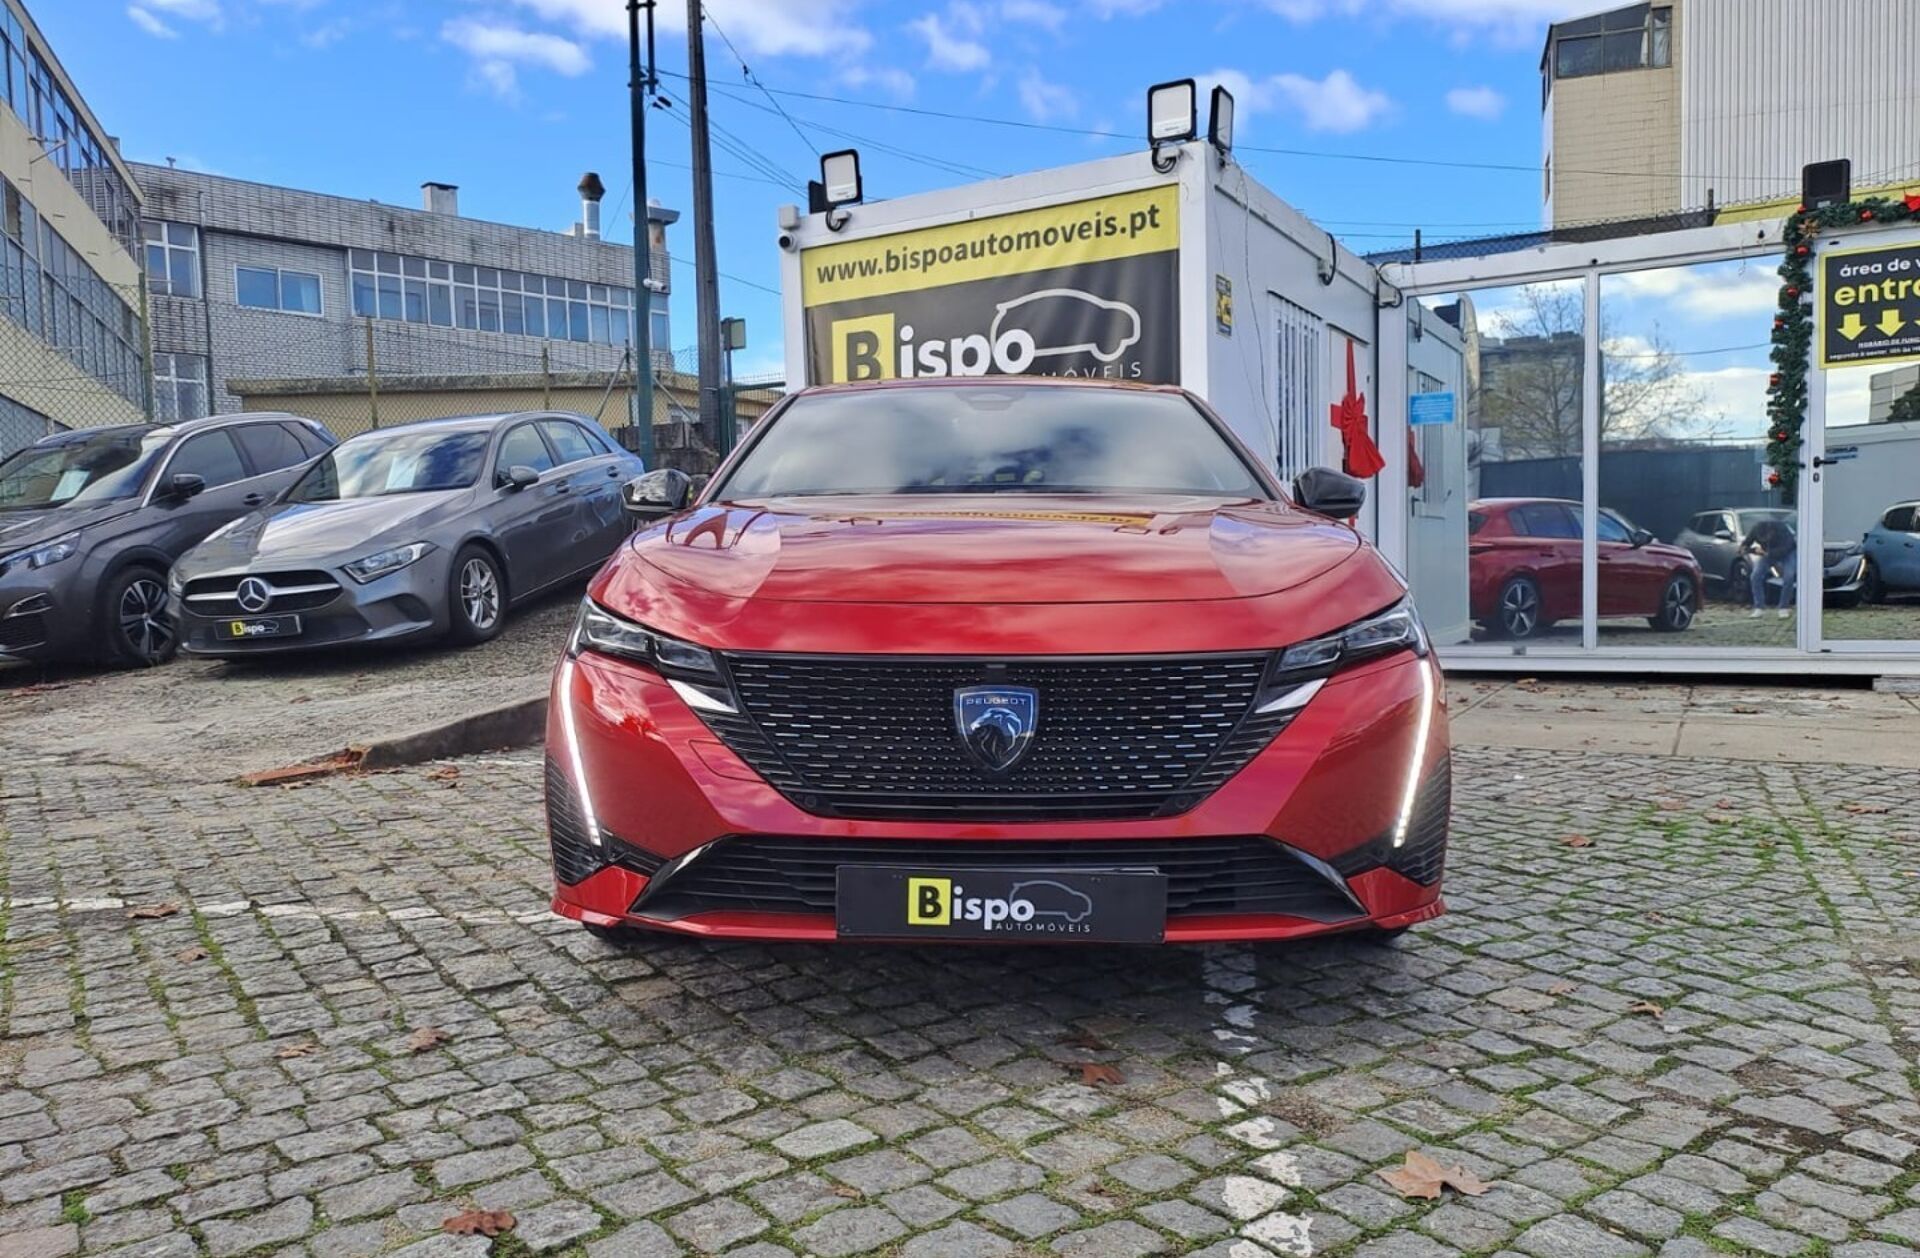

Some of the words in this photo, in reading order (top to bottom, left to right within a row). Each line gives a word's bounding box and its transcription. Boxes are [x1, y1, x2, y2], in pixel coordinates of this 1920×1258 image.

[817, 203, 1160, 284] www.bispoautomoveis.pt
[1840, 263, 1882, 277] área
[1887, 258, 1911, 272] de
[846, 326, 1035, 380] Bispo
[966, 698, 1027, 706] PEUGEOT
[917, 885, 1035, 931] Bispo
[995, 922, 1091, 934] AUTOMÓVEIS
